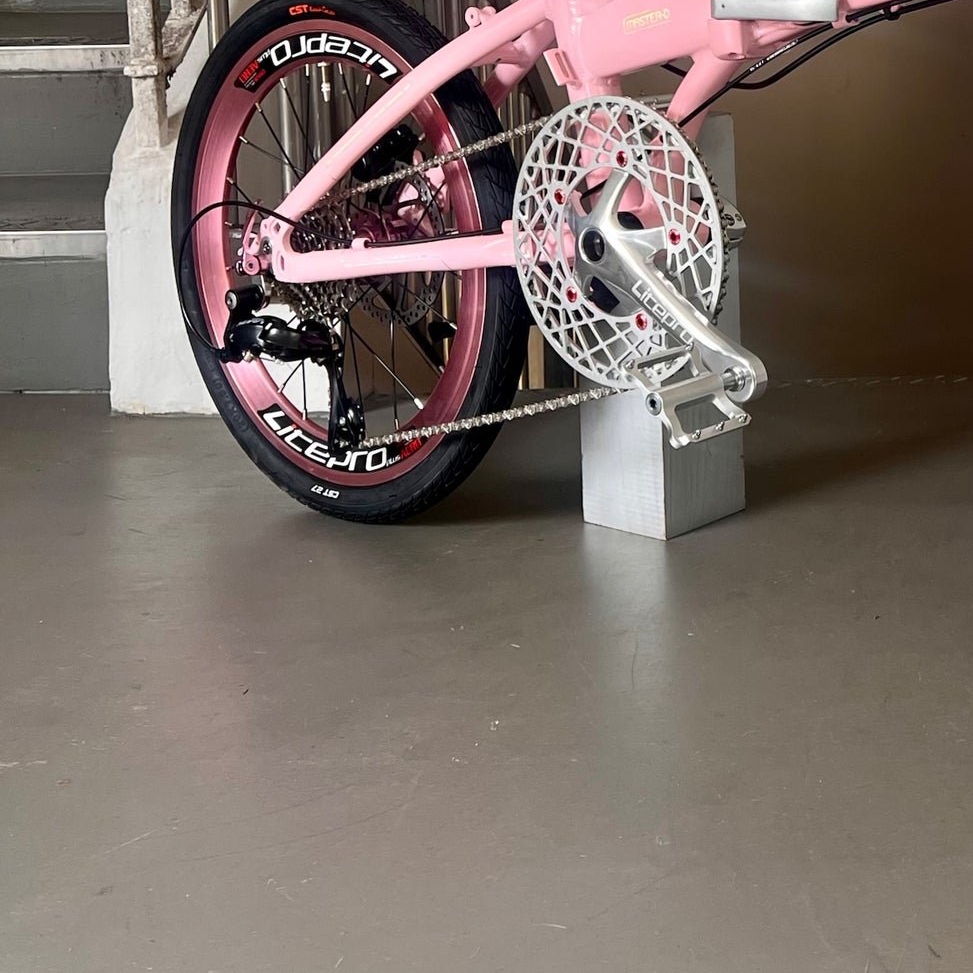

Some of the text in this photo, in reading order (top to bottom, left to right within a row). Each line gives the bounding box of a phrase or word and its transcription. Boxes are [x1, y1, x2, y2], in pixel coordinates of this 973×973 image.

[288, 3, 309, 16] CST
[270, 32, 399, 80] Litepro
[630, 279, 695, 345] Litepro
[262, 410, 388, 473] Litepro
